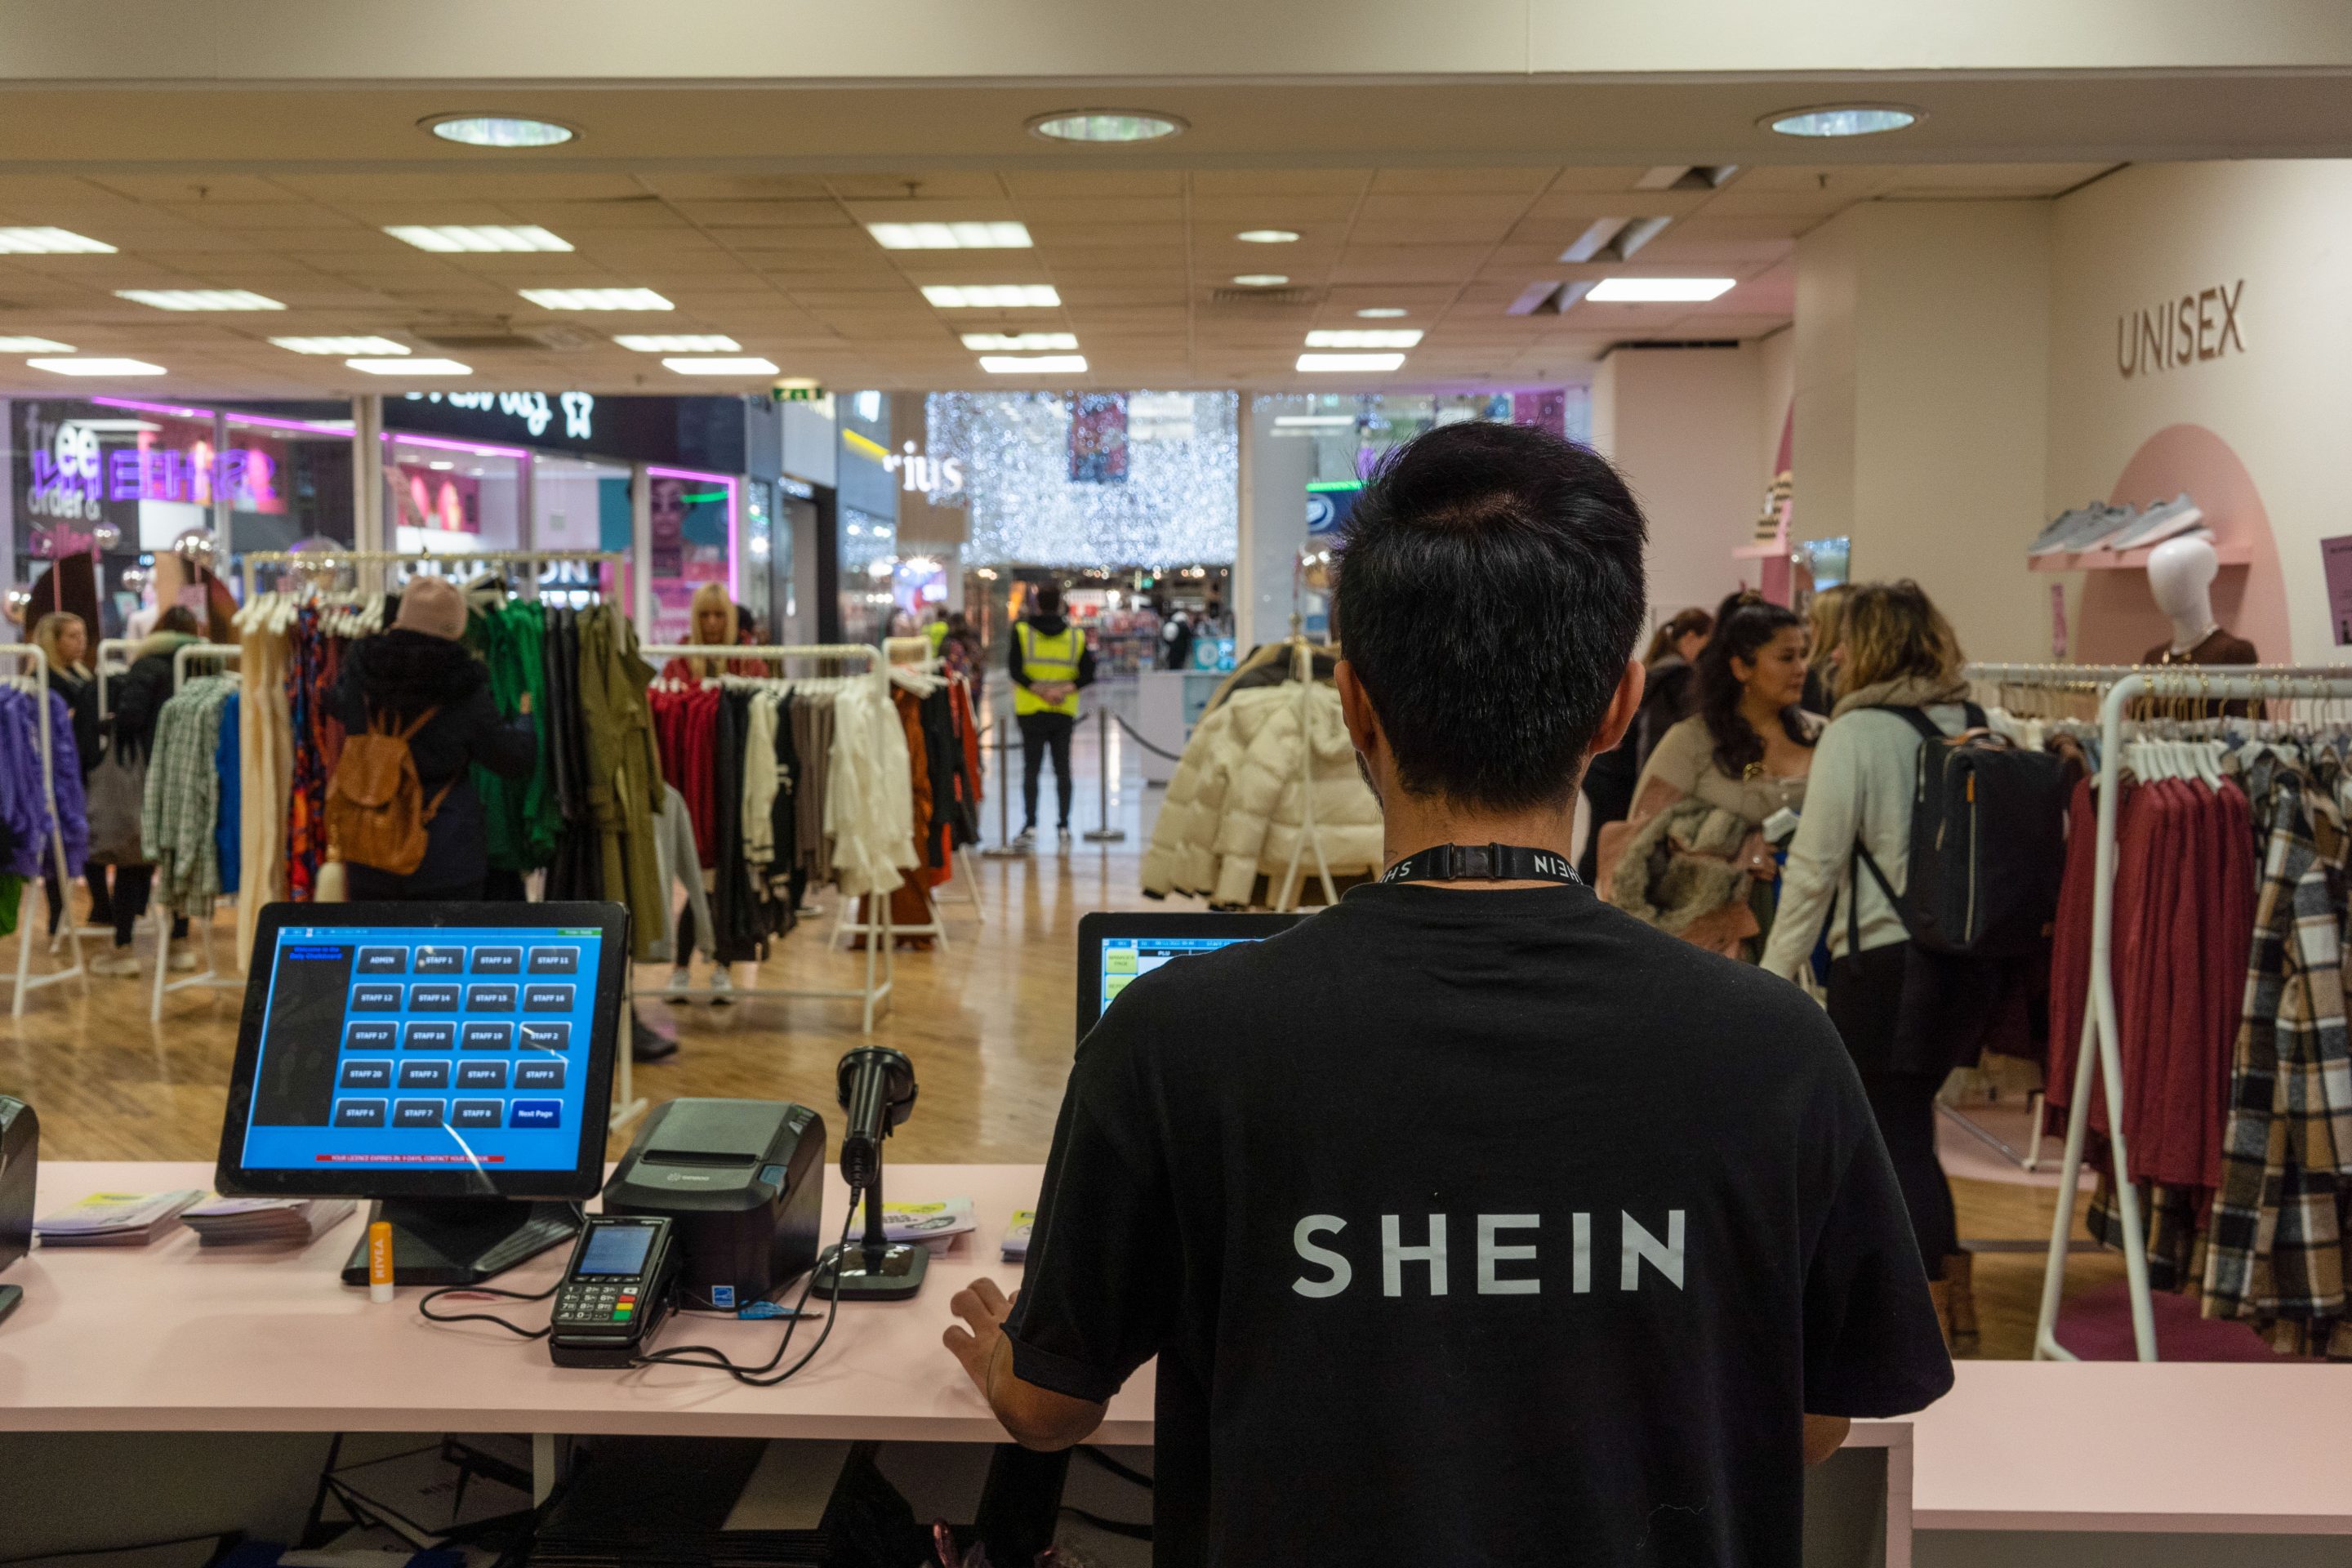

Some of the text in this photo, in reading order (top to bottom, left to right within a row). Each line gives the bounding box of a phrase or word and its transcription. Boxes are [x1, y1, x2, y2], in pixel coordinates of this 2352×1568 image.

[2118, 278, 2246, 379] UNISEX
[1534, 854, 1584, 885] HEIN
[370, 956, 394, 964] ADMIN
[425, 956, 447, 964] STAFF
[480, 956, 501, 964] STAFF
[537, 956, 559, 964] STAFF
[418, 994, 439, 1002] STAFF
[536, 1110, 553, 1118] Page
[1292, 1209, 1685, 1298] SHEIN
[374, 1239, 385, 1279] NIVEA
